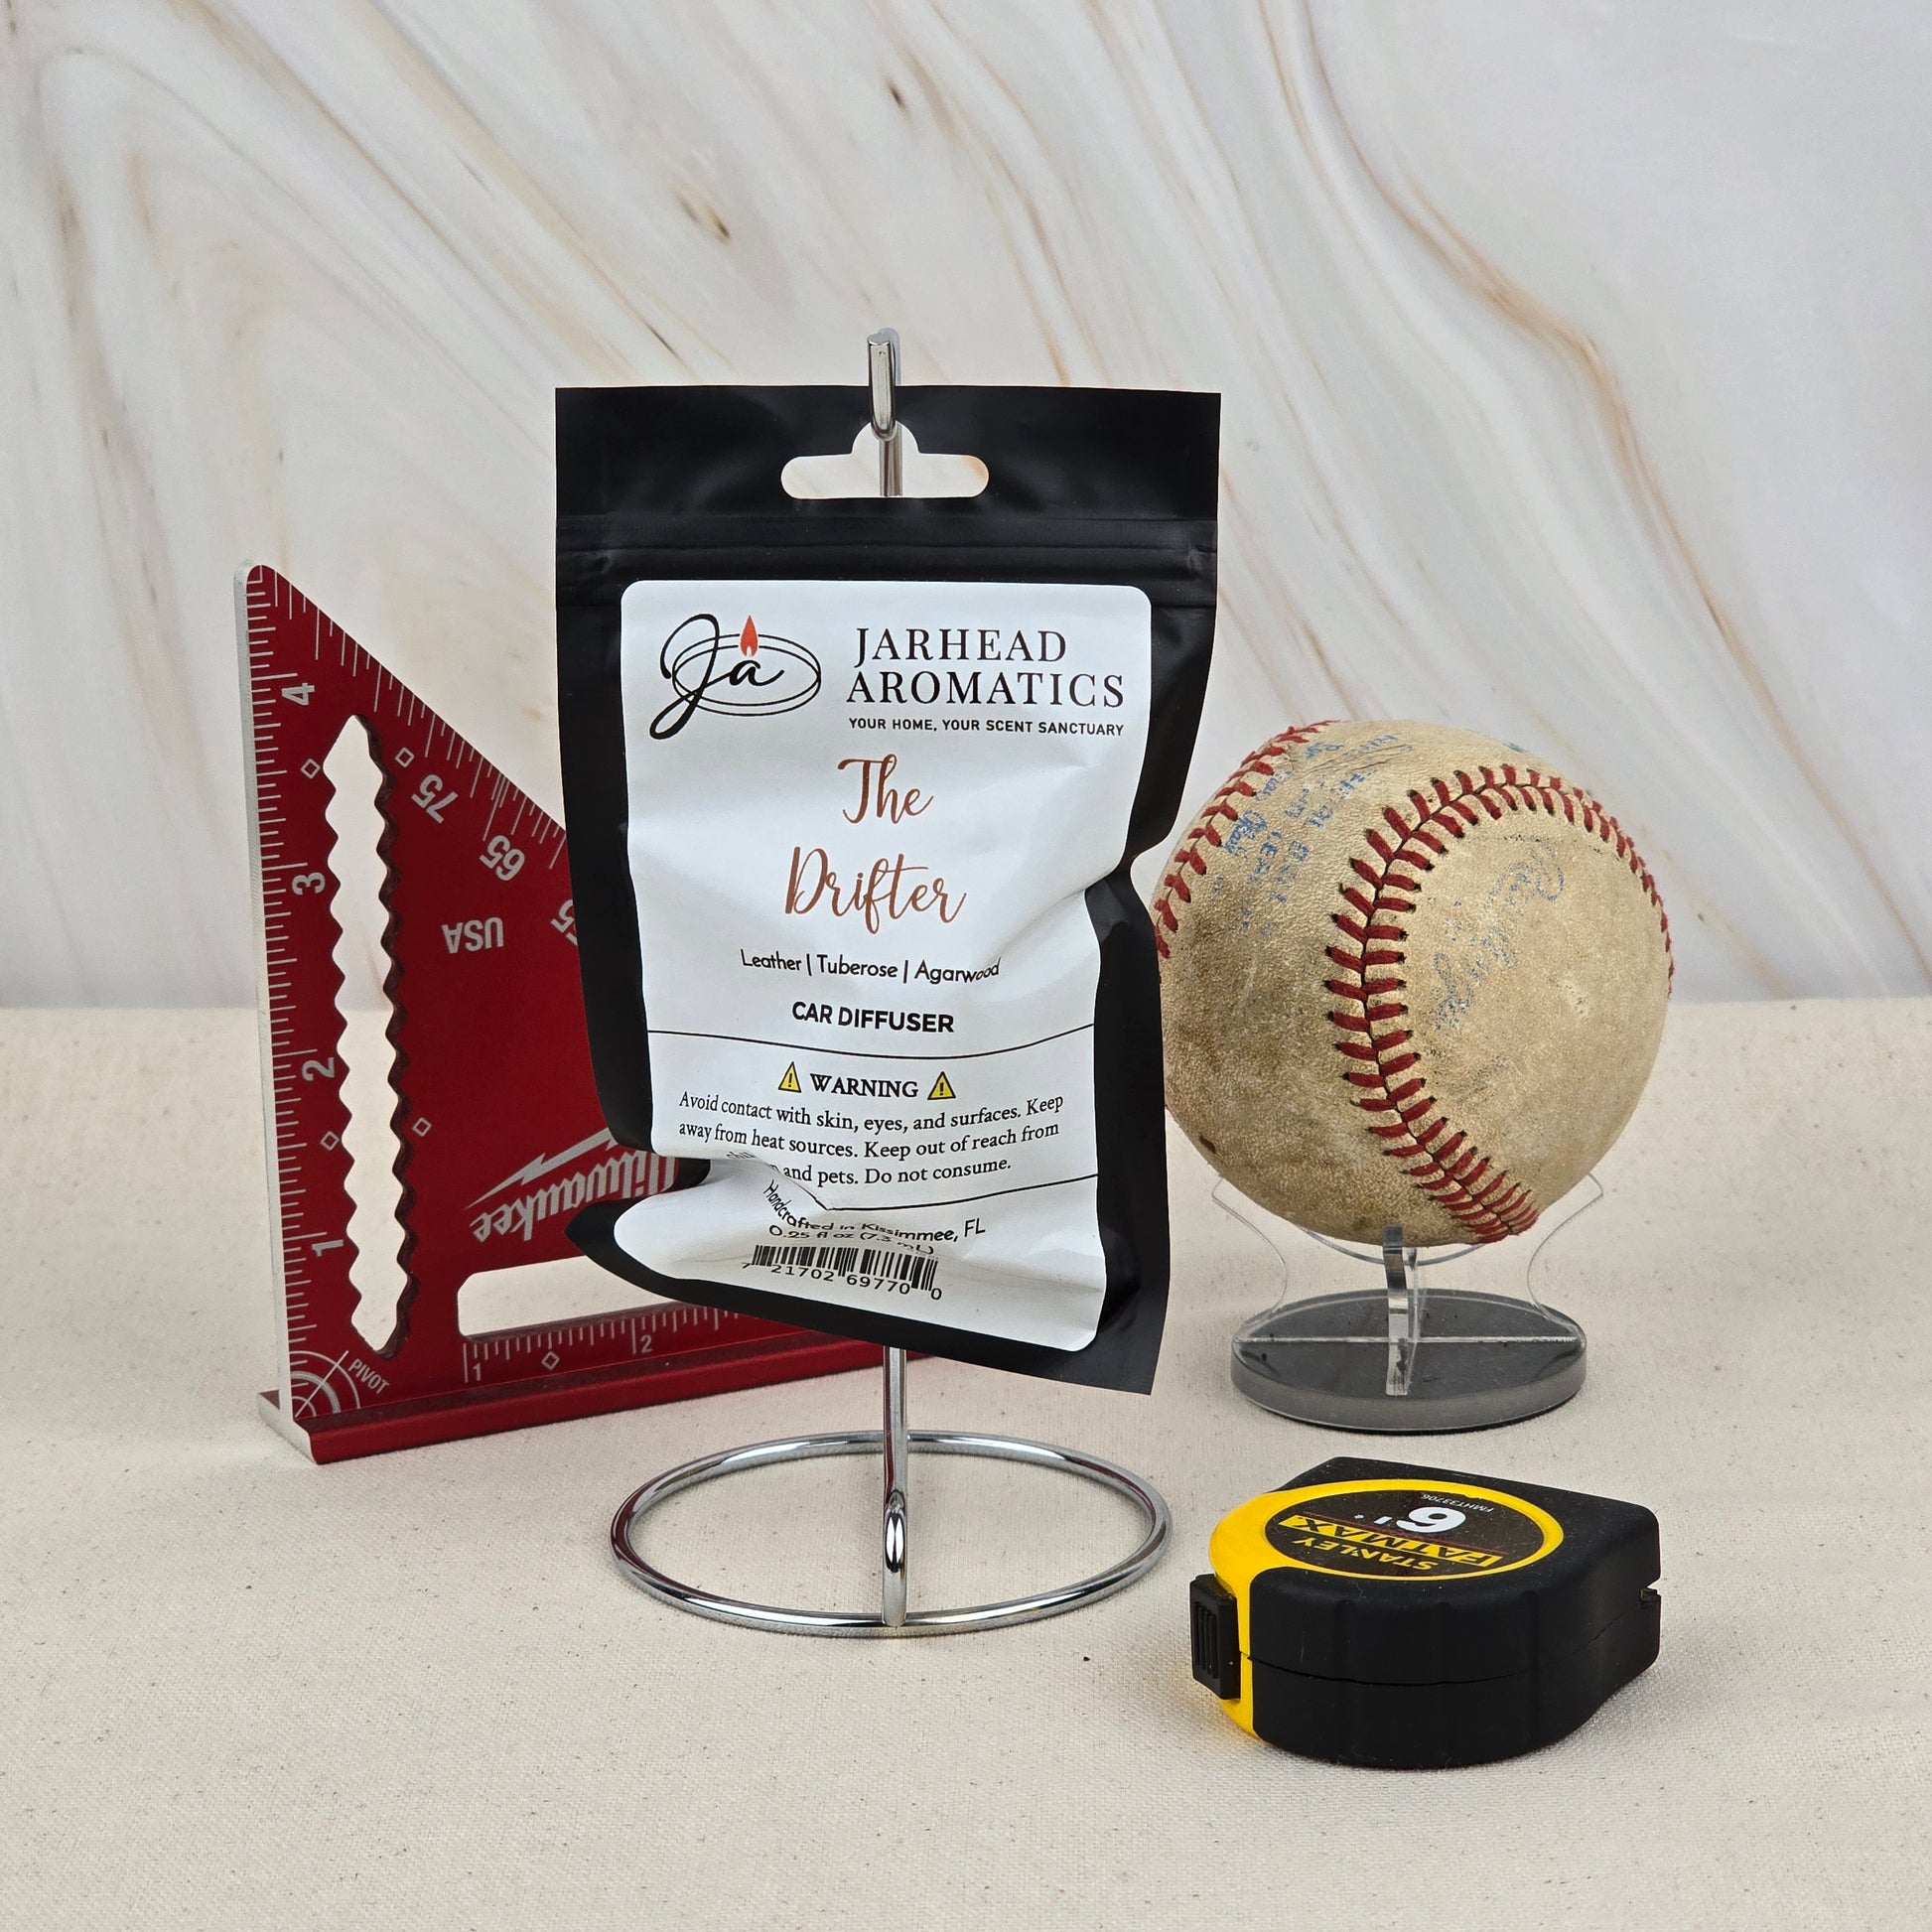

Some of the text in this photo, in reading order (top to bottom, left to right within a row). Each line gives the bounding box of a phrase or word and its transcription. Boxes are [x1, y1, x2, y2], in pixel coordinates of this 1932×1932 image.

[854, 627, 1066, 668] JARHEAD
[281, 682, 315, 706] 4
[846, 671, 1125, 708] AROMATICS
[849, 717, 1125, 737] YOUR HOME, YOUR SCENT SANCTUARY
[411, 773, 458, 823] 75
[837, 754, 934, 824] The
[479, 835, 525, 882] 65
[292, 872, 326, 896] 3
[784, 846, 967, 935] Drifter
[441, 916, 504, 954] USA
[741, 949, 801, 971] Leather
[817, 954, 897, 978] Tuberose
[914, 956, 1002, 985] Agarwood
[792, 1001, 954, 1033] CAR DIFFUSER
[302, 1056, 336, 1081] 2
[809, 1073, 918, 1098] WARNING
[679, 1091, 1064, 1135] Avoid contact with skin, eyes, and surfaces. Keep
[679, 1123, 1059, 1161] away from heat sources. Keep out of reach from
[782, 1159, 1012, 1187] and pets. Do not consume.
[763, 1179, 834, 1231] Handcrafted
[861, 1223, 959, 1242] Kissimmee,
[964, 1218, 986, 1237] FL
[312, 1238, 345, 1257] 1
[768, 1224, 810, 1239] 0.25
[770, 1264, 835, 1283] 21702
[846, 1274, 910, 1295] 69770
[930, 1288, 942, 1301] 0
[641, 1335, 652, 1353] 2
[348, 1358, 390, 1395] PIVOT
[473, 1363, 482, 1381] 1
[1292, 1537, 1440, 1571] STANLEY
[1294, 1516, 1493, 1566] FATMAX
